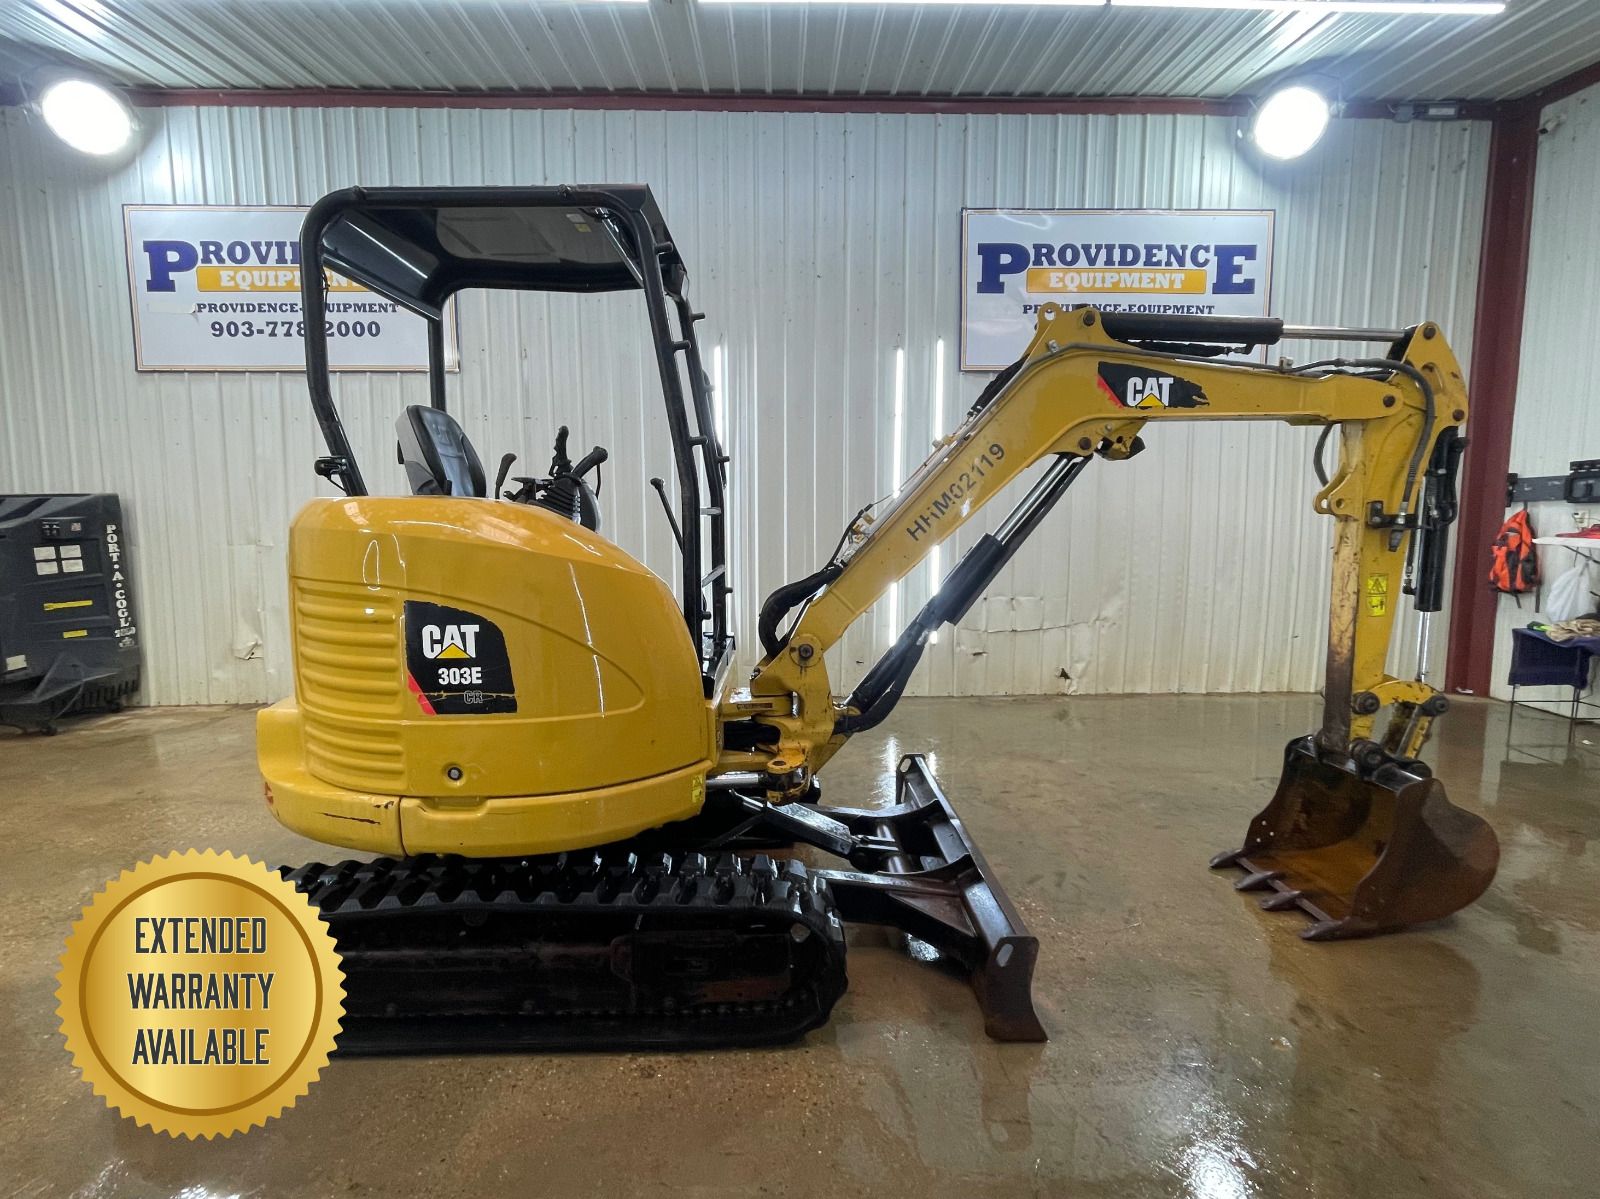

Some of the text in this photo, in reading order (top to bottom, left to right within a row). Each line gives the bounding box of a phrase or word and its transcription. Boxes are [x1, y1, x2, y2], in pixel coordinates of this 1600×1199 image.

[977, 243, 1257, 294] PROVIDENCE
[1050, 272, 1185, 291] EQUIPMENT
[210, 321, 381, 338] 903-7782000
[1126, 376, 1174, 407] CAT
[422, 624, 480, 659] CAT
[438, 667, 483, 685] 303E
[463, 690, 483, 704] CR
